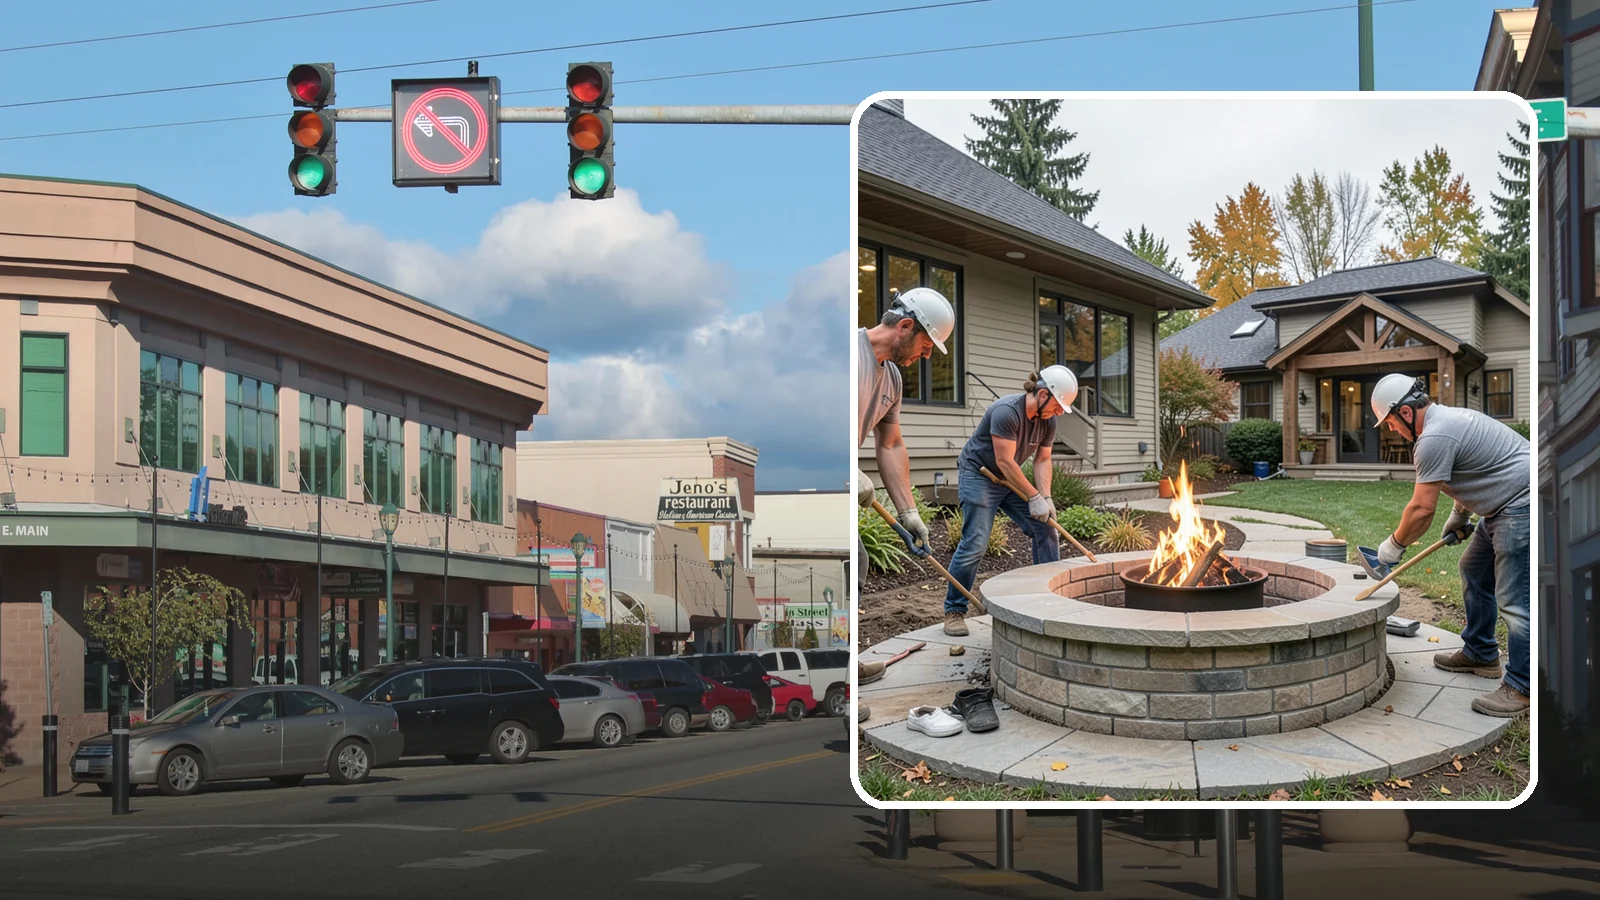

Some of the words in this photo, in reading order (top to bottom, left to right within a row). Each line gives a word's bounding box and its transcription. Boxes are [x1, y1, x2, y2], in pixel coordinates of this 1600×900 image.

[670, 480, 728, 495] Jeno's
[665, 496, 731, 509] restaurant
[686, 509, 715, 519] American
[715, 510, 737, 519] Cuisine
[2, 525, 13, 536] E.
[15, 525, 49, 536] MAIN
[797, 608, 828, 617] Street
